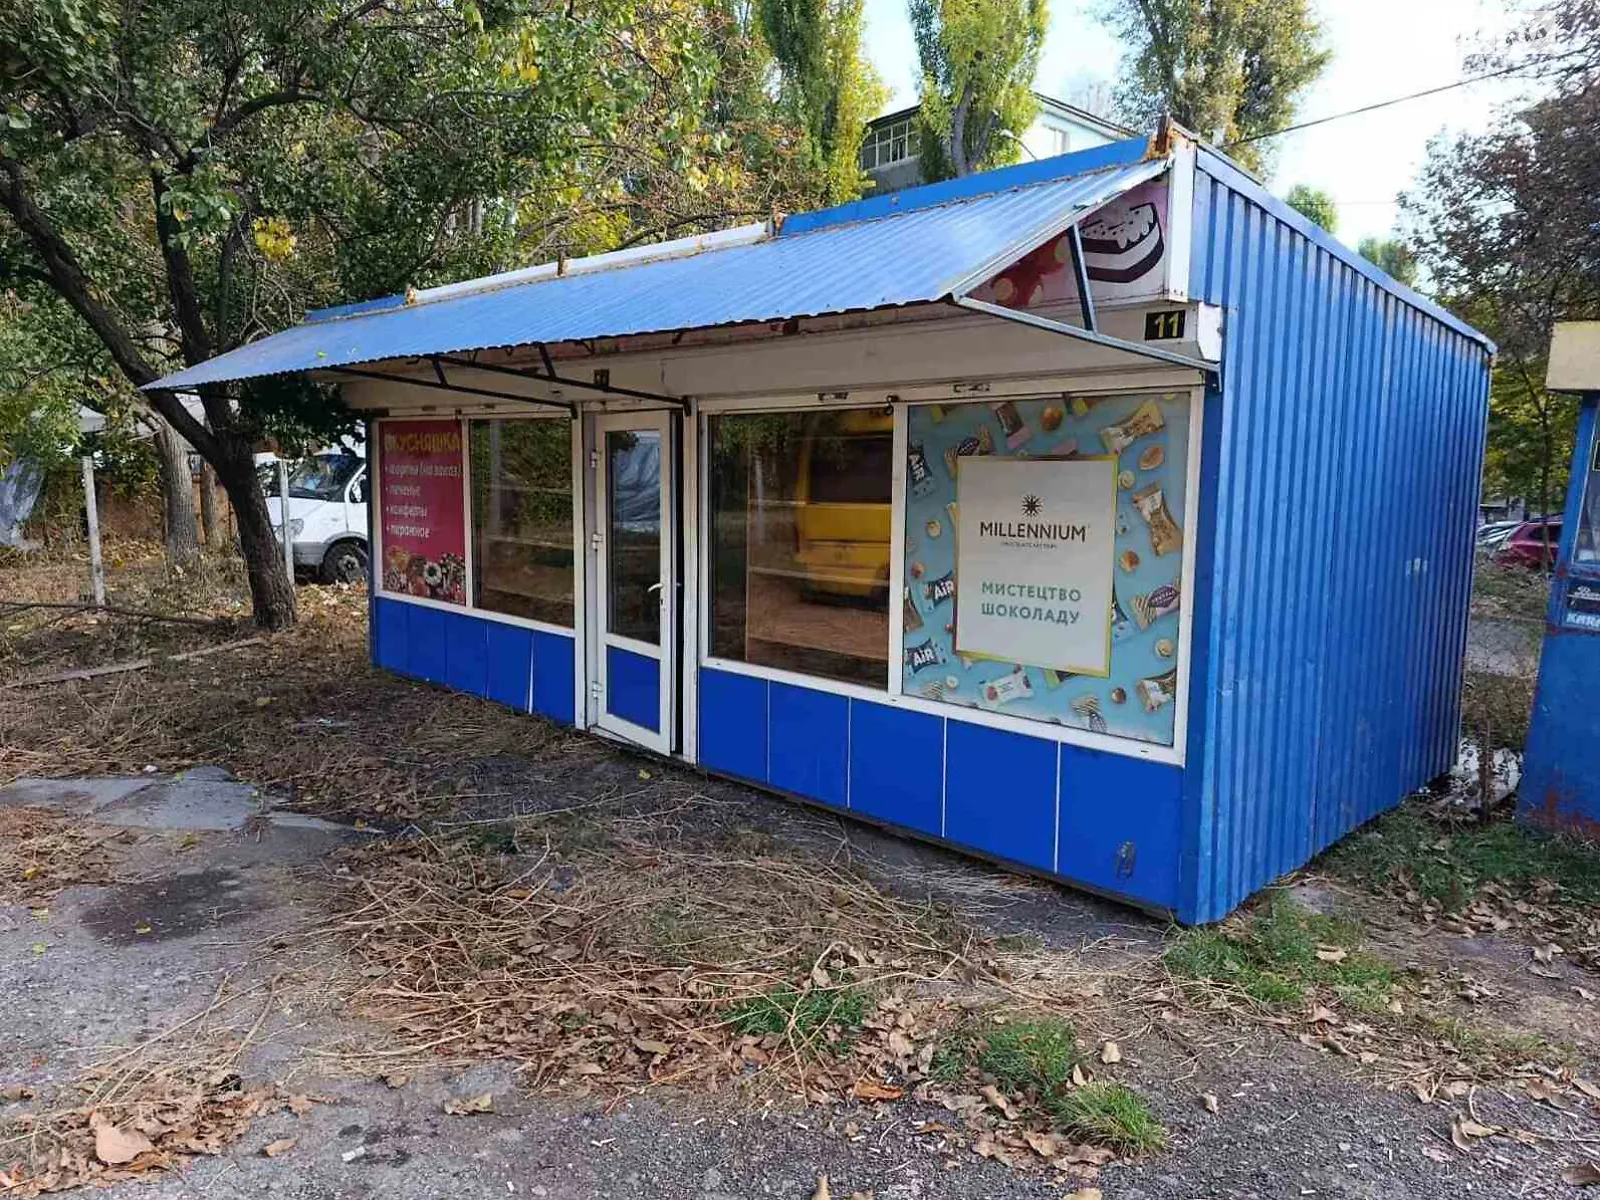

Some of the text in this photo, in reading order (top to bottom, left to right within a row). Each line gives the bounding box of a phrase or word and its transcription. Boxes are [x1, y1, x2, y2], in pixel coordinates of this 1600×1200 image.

[1154, 311, 1180, 338] 11
[980, 521, 1086, 542] MILLENNIUM
[981, 581, 1081, 602] МИСТЕЦТВО
[981, 603, 1080, 625] ШОКОЛАДУ
